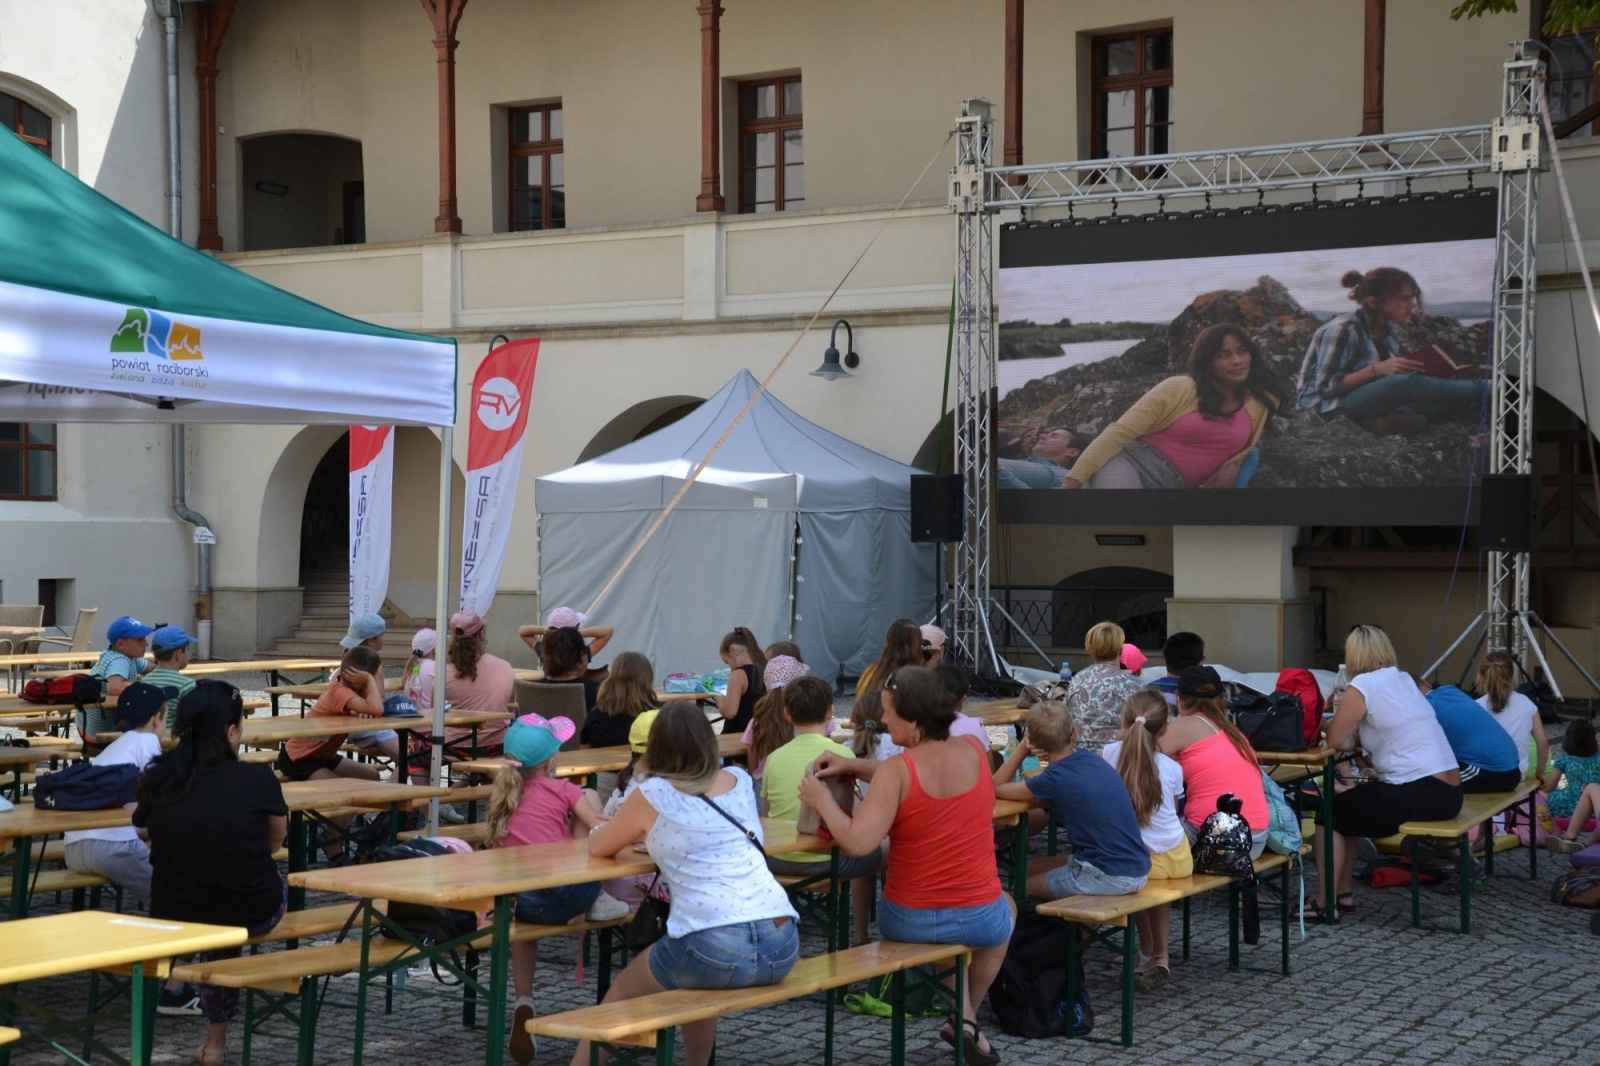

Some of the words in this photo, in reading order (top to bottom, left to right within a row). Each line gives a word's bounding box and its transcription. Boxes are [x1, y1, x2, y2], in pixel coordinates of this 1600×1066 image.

[111, 358, 150, 372] powiat
[157, 363, 209, 378] raciborski
[180, 379, 207, 390] kultur
